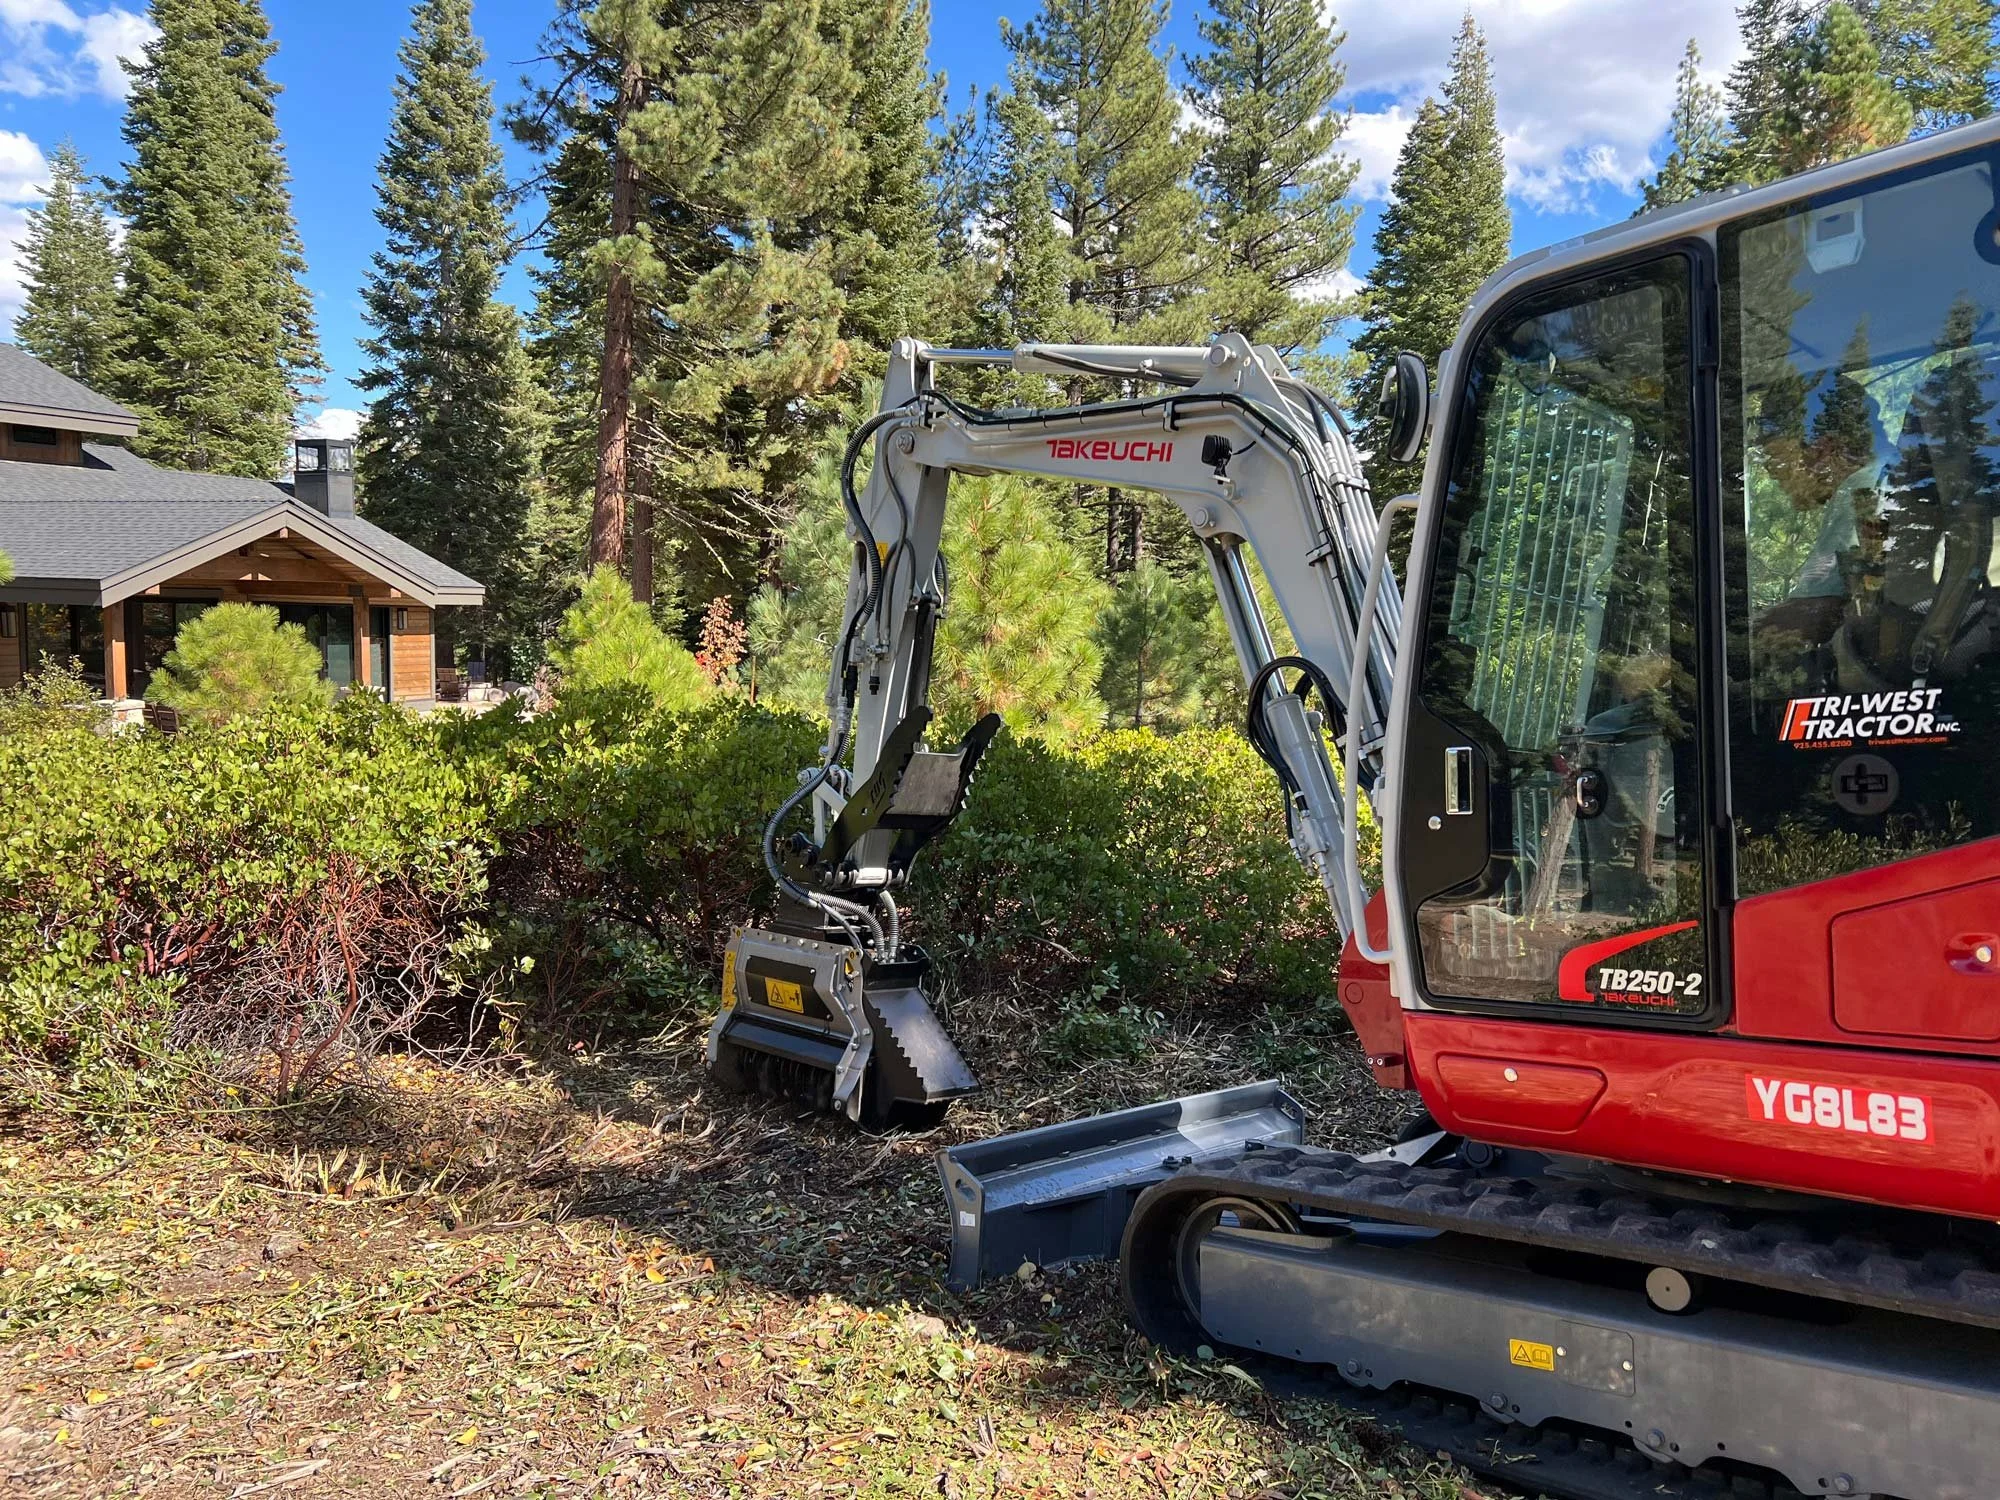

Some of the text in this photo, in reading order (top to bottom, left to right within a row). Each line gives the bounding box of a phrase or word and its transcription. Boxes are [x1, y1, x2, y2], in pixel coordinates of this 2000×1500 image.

[1796, 689, 1942, 717] TRI-WEST
[1801, 714, 1960, 740] TRACTOR INC.
[1600, 968, 1702, 995] TB250-2
[1752, 1078, 1927, 1140] YG8L83
